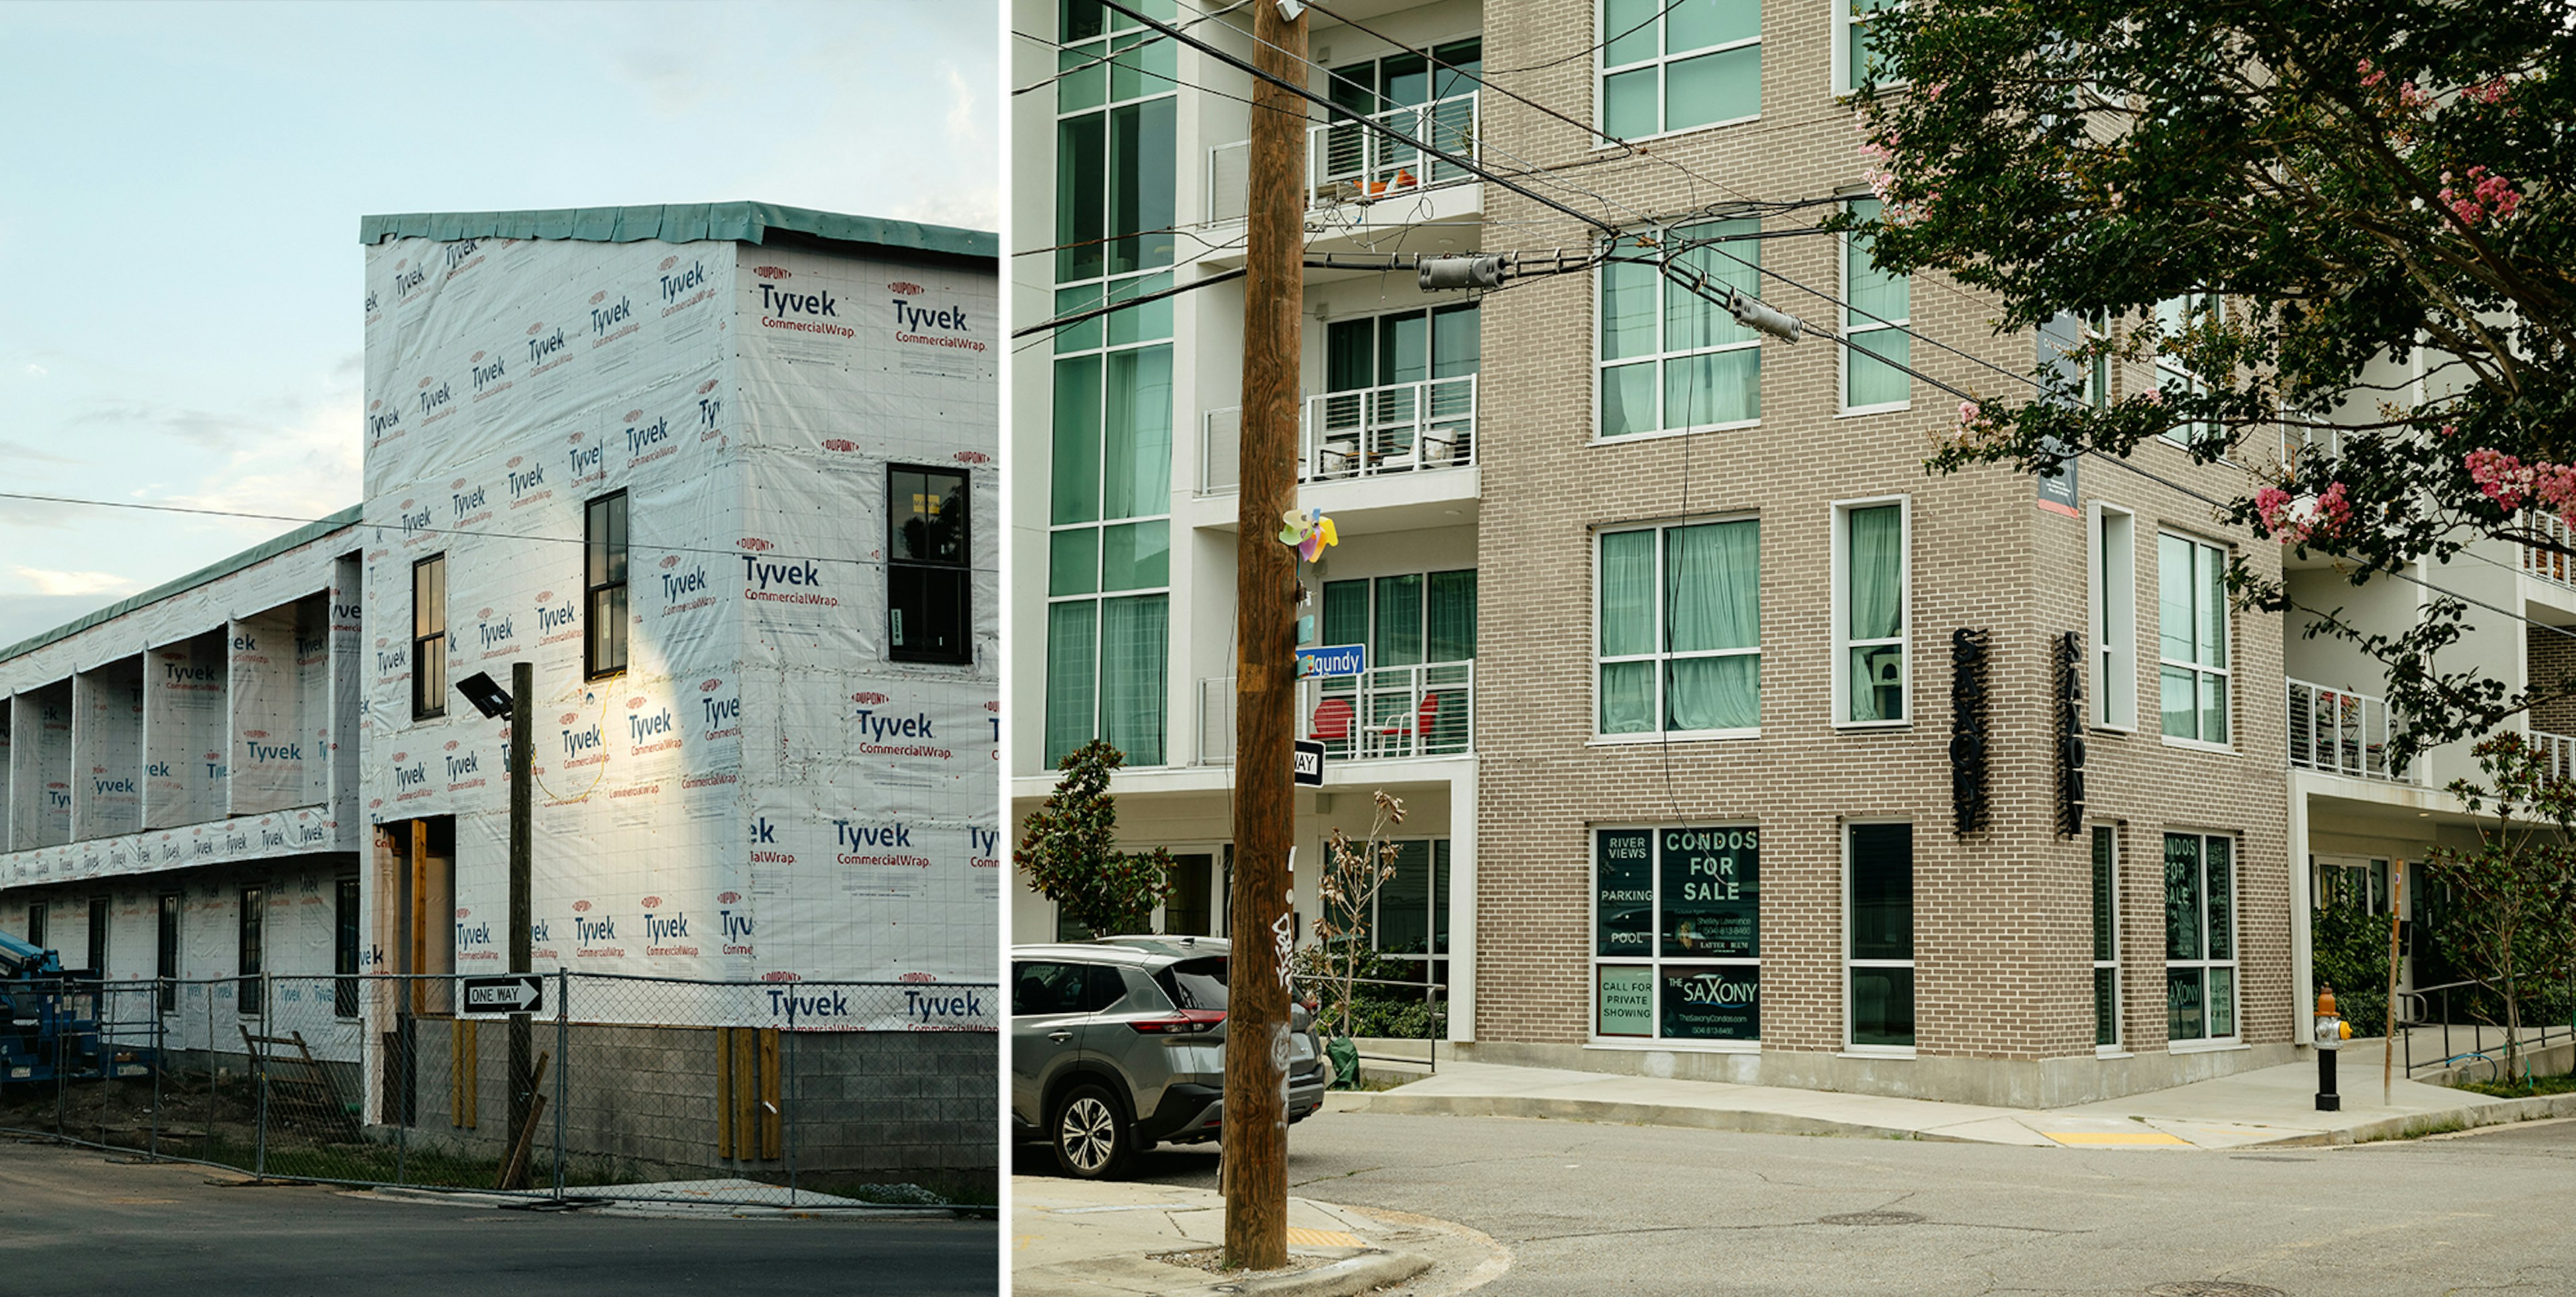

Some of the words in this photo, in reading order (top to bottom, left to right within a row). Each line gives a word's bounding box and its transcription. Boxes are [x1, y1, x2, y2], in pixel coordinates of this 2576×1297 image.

[661, 260, 704, 303] Tyvek
[759, 266, 788, 280] DUPONT
[591, 295, 630, 335] Tyvek
[759, 283, 837, 318] Tyvek
[892, 299, 968, 332] Tyvek
[761, 316, 855, 339] CommercialWrap
[896, 331, 985, 353] CommercialWrap
[529, 327, 565, 365] Tyvek
[472, 356, 504, 391] Tyvek
[420, 382, 451, 415] Tyvek
[370, 407, 400, 438] Tyvek
[626, 416, 667, 456] Tyvek
[508, 463, 544, 499] Tyvek
[452, 485, 486, 519] Tyvek
[402, 506, 432, 537] Tyvek
[741, 537, 770, 551] DUPONT
[662, 565, 706, 603] Tyvek
[742, 555, 820, 590] Tyvek
[744, 588, 838, 608] CommercialWrap
[479, 616, 513, 650] Tyvek
[537, 601, 575, 635] Tyvek
[165, 663, 216, 683] Tyvek
[377, 646, 407, 676] Tyvek
[1315, 651, 1360, 676] gundy
[703, 696, 740, 729] Tyve
[856, 692, 886, 705] DUPONT
[562, 723, 601, 758] Tyvek
[629, 707, 672, 745] Tyvek
[856, 709, 933, 742] Tyvek
[1950, 628, 1980, 832] SAXONY
[2064, 630, 2086, 835] SAXONY
[247, 741, 303, 763] Tyvek
[859, 741, 953, 760] CommercialWrap
[395, 762, 425, 791] Tyvek
[445, 751, 478, 781] Tyvek
[833, 820, 912, 853] Tyvek
[1609, 837, 1646, 848] RIVER
[1666, 831, 1758, 851] CONDOS
[2164, 838, 2196, 856] NDOS
[837, 852, 930, 868] CommercialWrap
[1609, 848, 1647, 859] VIEWS
[1690, 857, 1734, 876] FOR
[2165, 862, 2185, 880] FOR
[1601, 890, 1653, 902] PARKING
[1684, 882, 1740, 901] SALE
[457, 922, 490, 950] Tyvek
[575, 915, 616, 947] Tyvek
[645, 912, 688, 945] Tyvek
[720, 910, 753, 943] Tyv
[1611, 932, 1644, 944] POOL
[359, 944, 383, 966] vek
[472, 988, 494, 1003] ONE
[496, 987, 519, 1002] WAY
[1603, 982, 1628, 992] CALL
[1631, 982, 1652, 992] FOR
[1607, 995, 1648, 1005] PRIVATE
[1668, 977, 1682, 988] THE
[1684, 978, 1758, 1004] SAXONY
[2167, 980, 2200, 1006] AXONY
[767, 990, 848, 1024] Tyvek
[904, 990, 982, 1023] Tyvek
[1603, 1008, 1651, 1018] SHOWING
